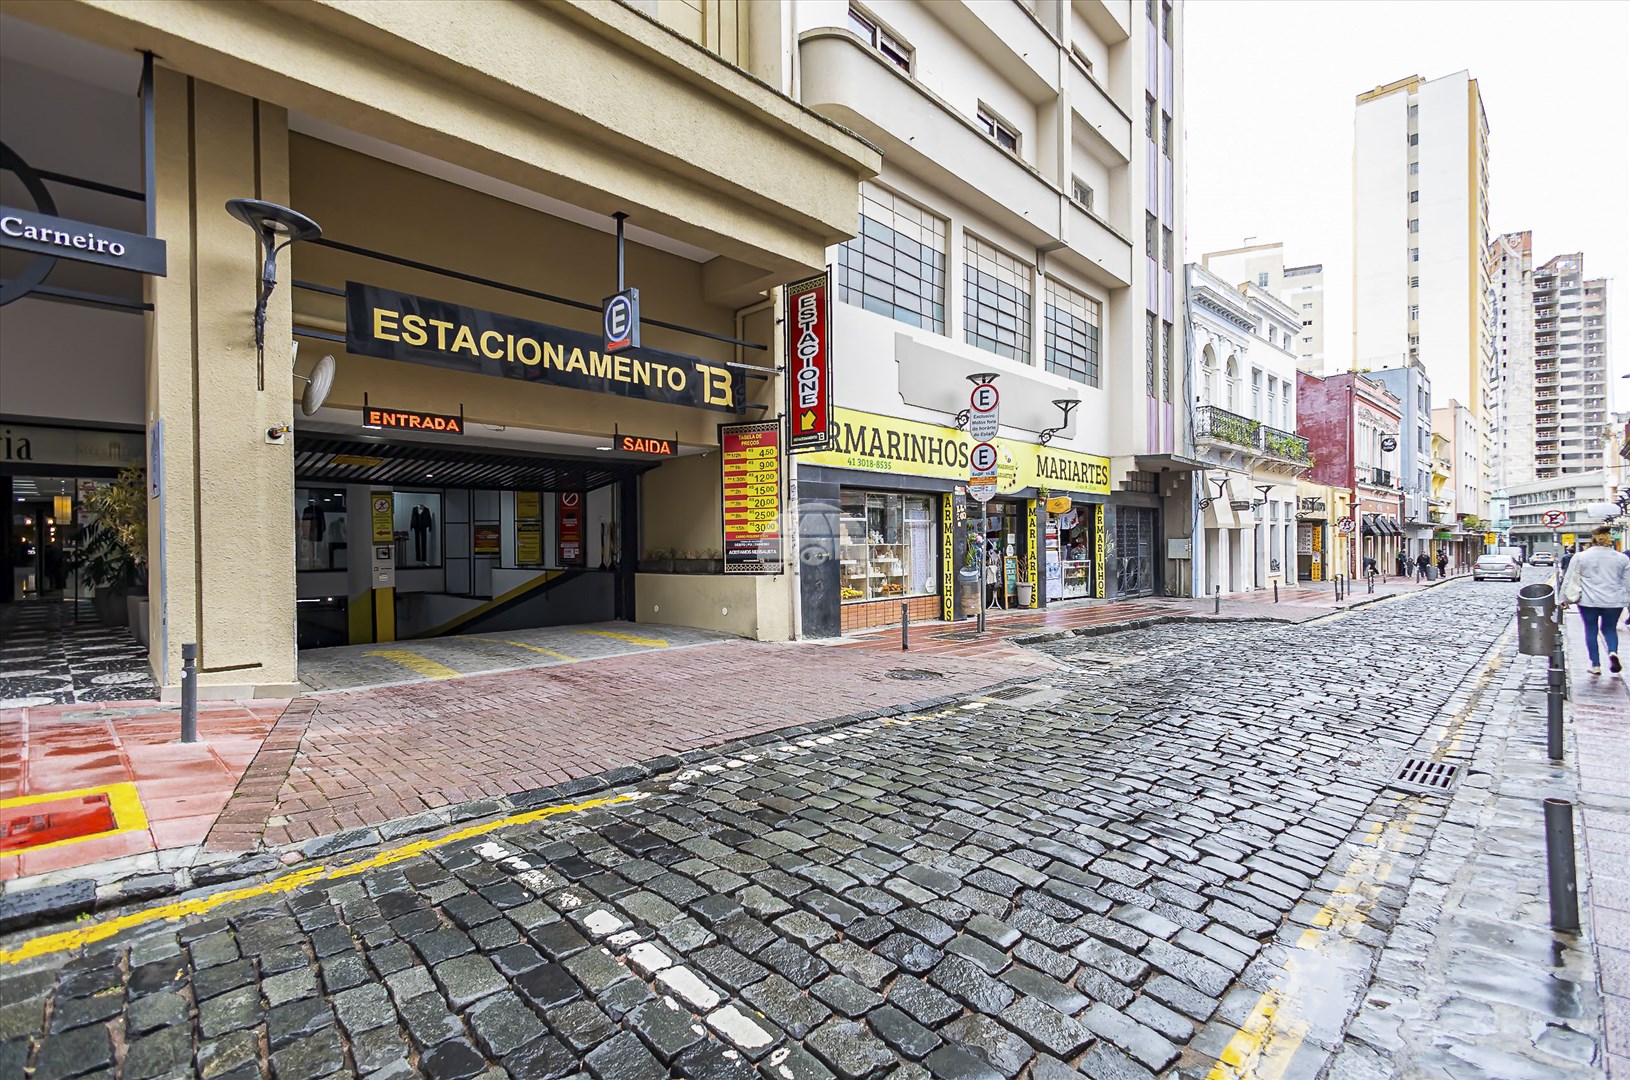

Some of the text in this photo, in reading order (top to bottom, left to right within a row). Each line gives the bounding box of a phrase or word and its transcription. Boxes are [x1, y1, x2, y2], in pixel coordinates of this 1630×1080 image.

[0, 216, 126, 256] Carneiro
[612, 303, 626, 335] E
[373, 307, 687, 392] ESTACIONAMENTO
[798, 293, 819, 408] ESTACIONE
[979, 389, 990, 406] E
[369, 411, 460, 432] ENTRADA
[623, 436, 671, 454] SAIDA
[828, 421, 1108, 485] RMARINHOS MARIARTES
[847, 457, 892, 470] 41 3018-8535
[979, 449, 989, 466] E
[944, 496, 953, 621] ARMARINHOS
[1028, 507, 1037, 604] MARIARTES
[1096, 506, 1104, 599] ARMARINHOS
